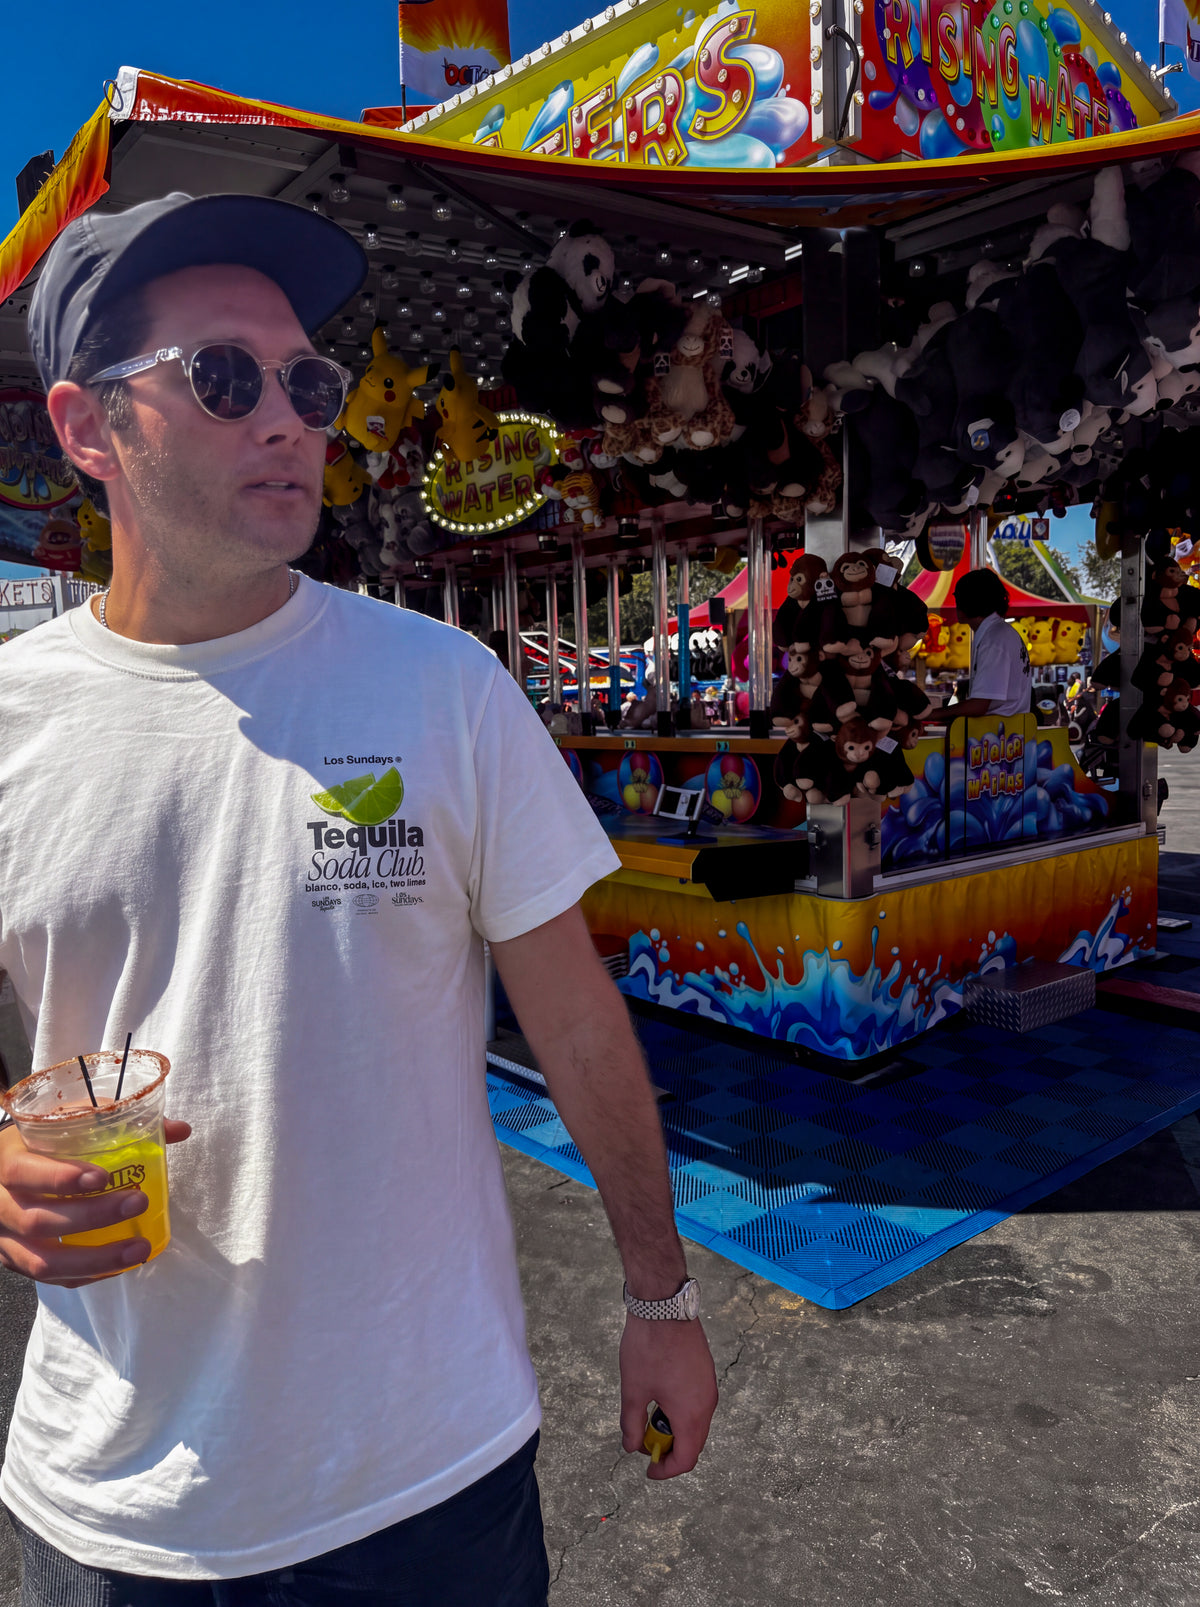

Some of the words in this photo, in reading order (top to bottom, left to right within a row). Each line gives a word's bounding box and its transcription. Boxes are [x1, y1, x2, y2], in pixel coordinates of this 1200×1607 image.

[884, 0, 1020, 105] RISING
[441, 473, 533, 518] WATER
[324, 756, 344, 765] Los
[346, 755, 394, 766] Sundays
[306, 819, 424, 856] Tequila
[308, 849, 371, 881] Soda
[376, 849, 425, 878] Club.
[305, 883, 341, 893] blanco,
[343, 881, 370, 890] soda,
[372, 880, 388, 889] ice,
[390, 879, 406, 888] two
[407, 879, 426, 887] limes
